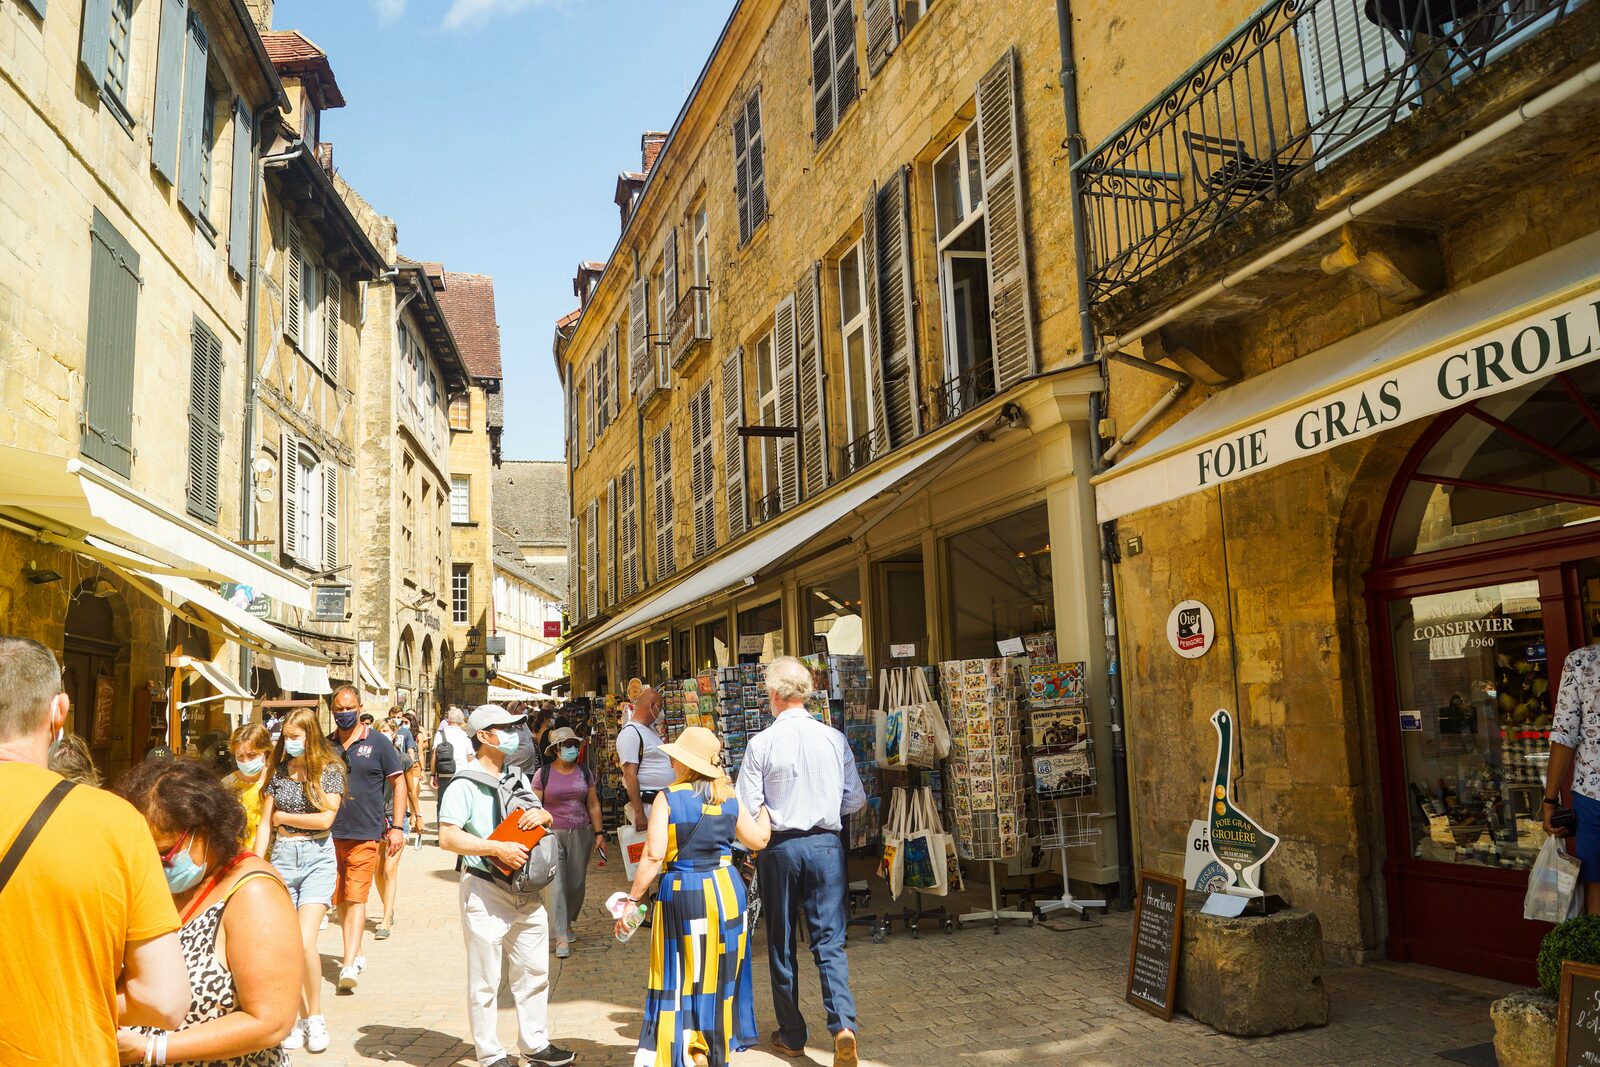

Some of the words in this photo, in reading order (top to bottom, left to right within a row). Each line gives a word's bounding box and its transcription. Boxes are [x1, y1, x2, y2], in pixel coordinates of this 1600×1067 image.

[1197, 428, 1269, 487] FOIE
[1294, 377, 1401, 451] GRAS
[1427, 599, 1494, 619] ARTISAN
[1180, 612, 1195, 625] Oie
[1413, 617, 1514, 641] CONSERVIER
[1469, 637, 1494, 648] 1960
[1039, 766, 1050, 774] 66
[1202, 827, 1208, 837] F
[1215, 818, 1232, 828] FOIE
[1232, 818, 1252, 832] GRAS
[1211, 829, 1256, 843] GROLIÈRE
[1193, 838, 1210, 853] GR
